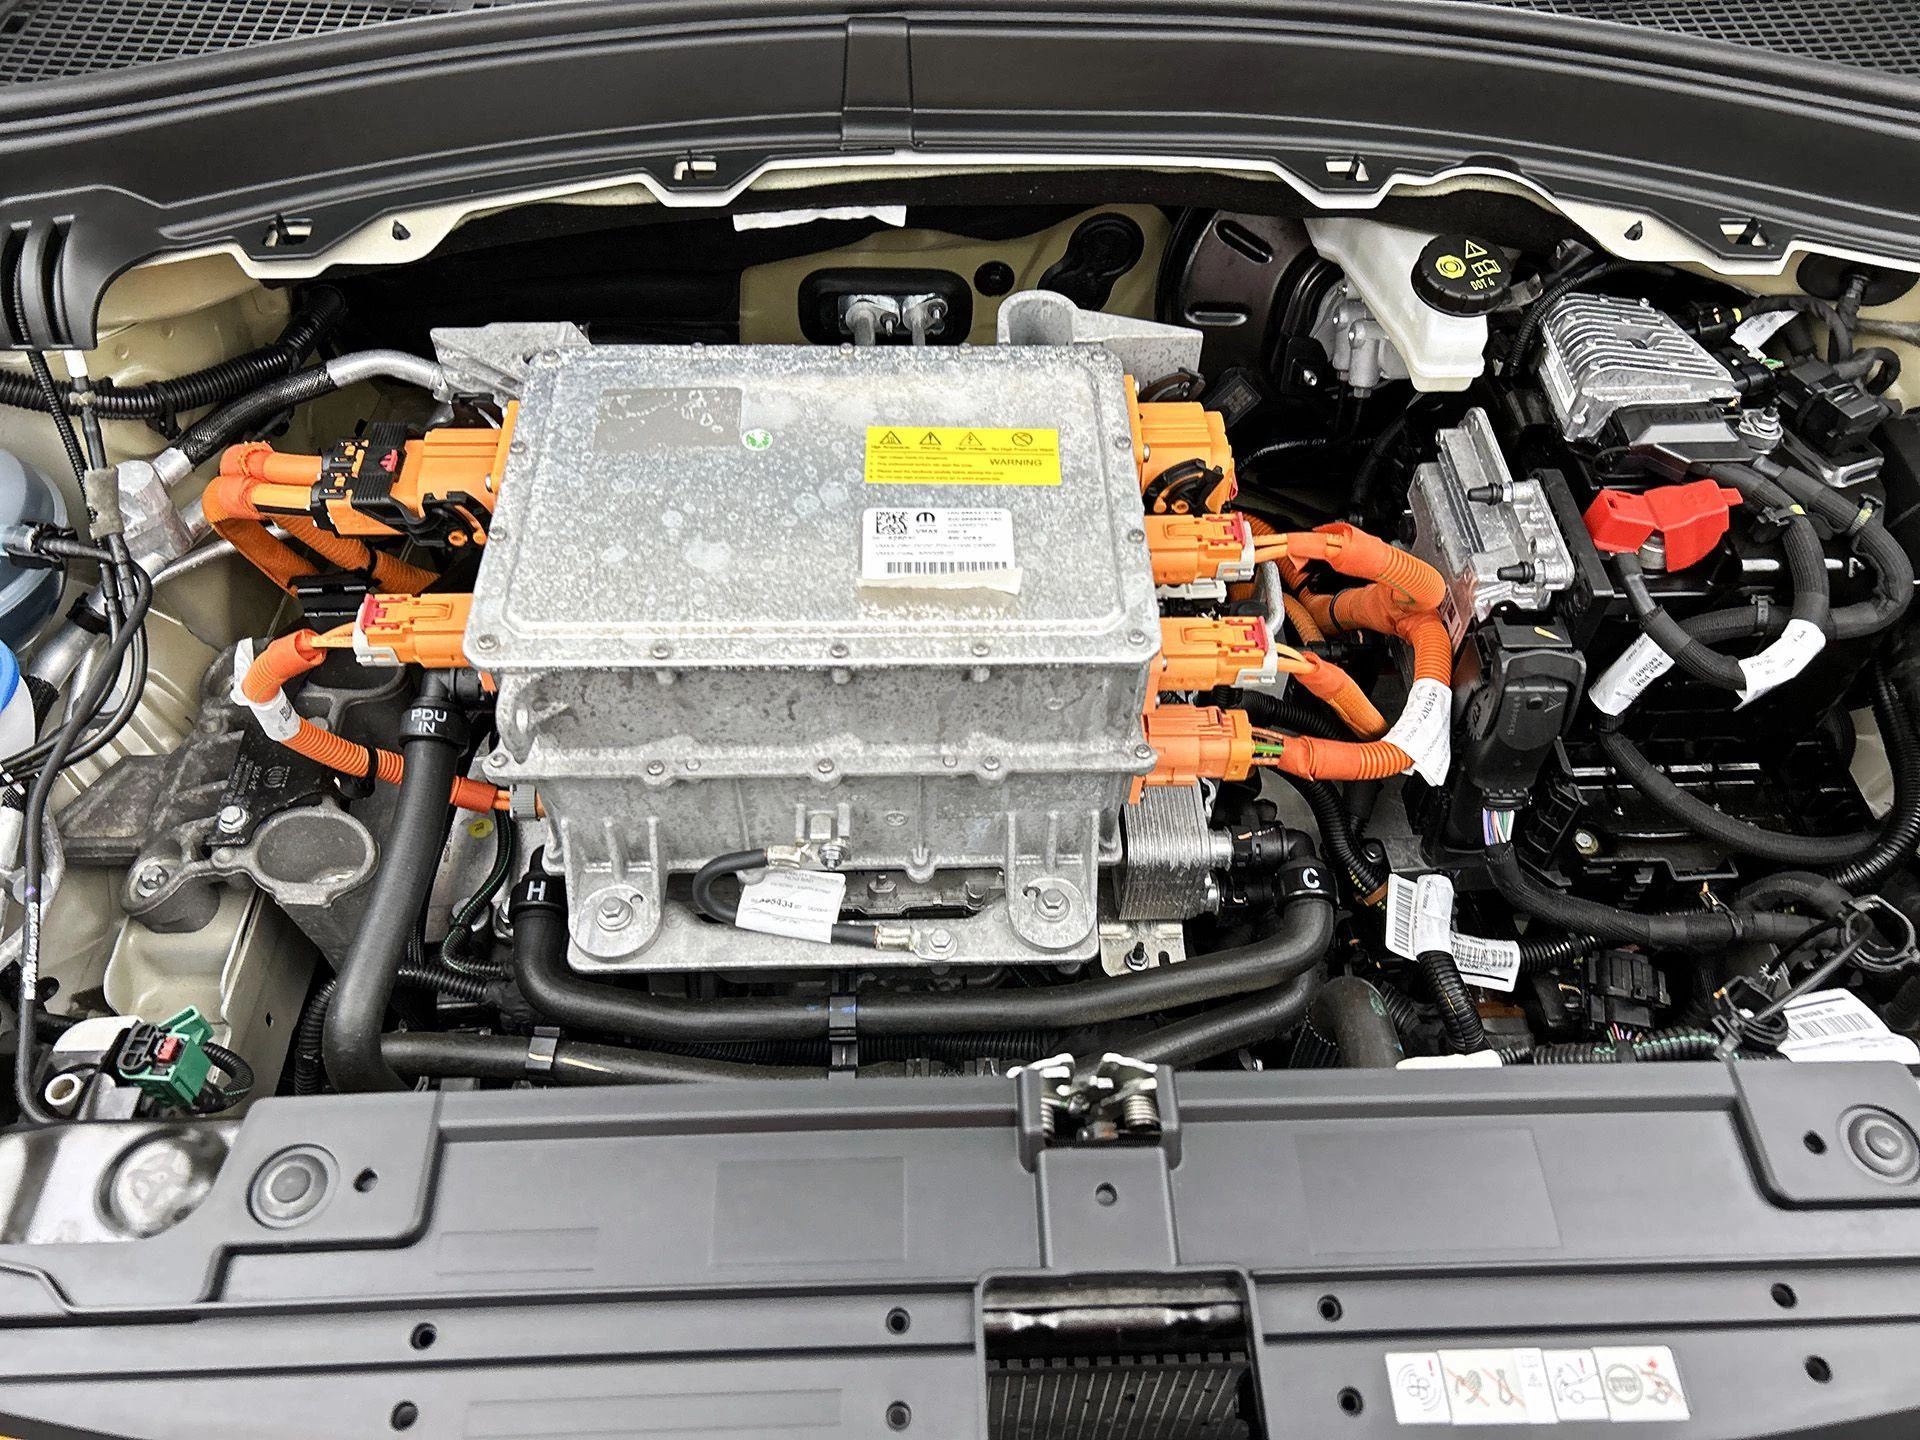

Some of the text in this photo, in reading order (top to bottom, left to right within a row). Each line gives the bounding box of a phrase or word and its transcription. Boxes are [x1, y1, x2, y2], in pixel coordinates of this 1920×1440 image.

[1469, 277, 1496, 291] DOT 4
[989, 458, 1042, 467] WARNING
[411, 708, 447, 723] PDU
[418, 721, 436, 734] IN
[1302, 867, 1320, 889] C
[526, 880, 547, 901] H
